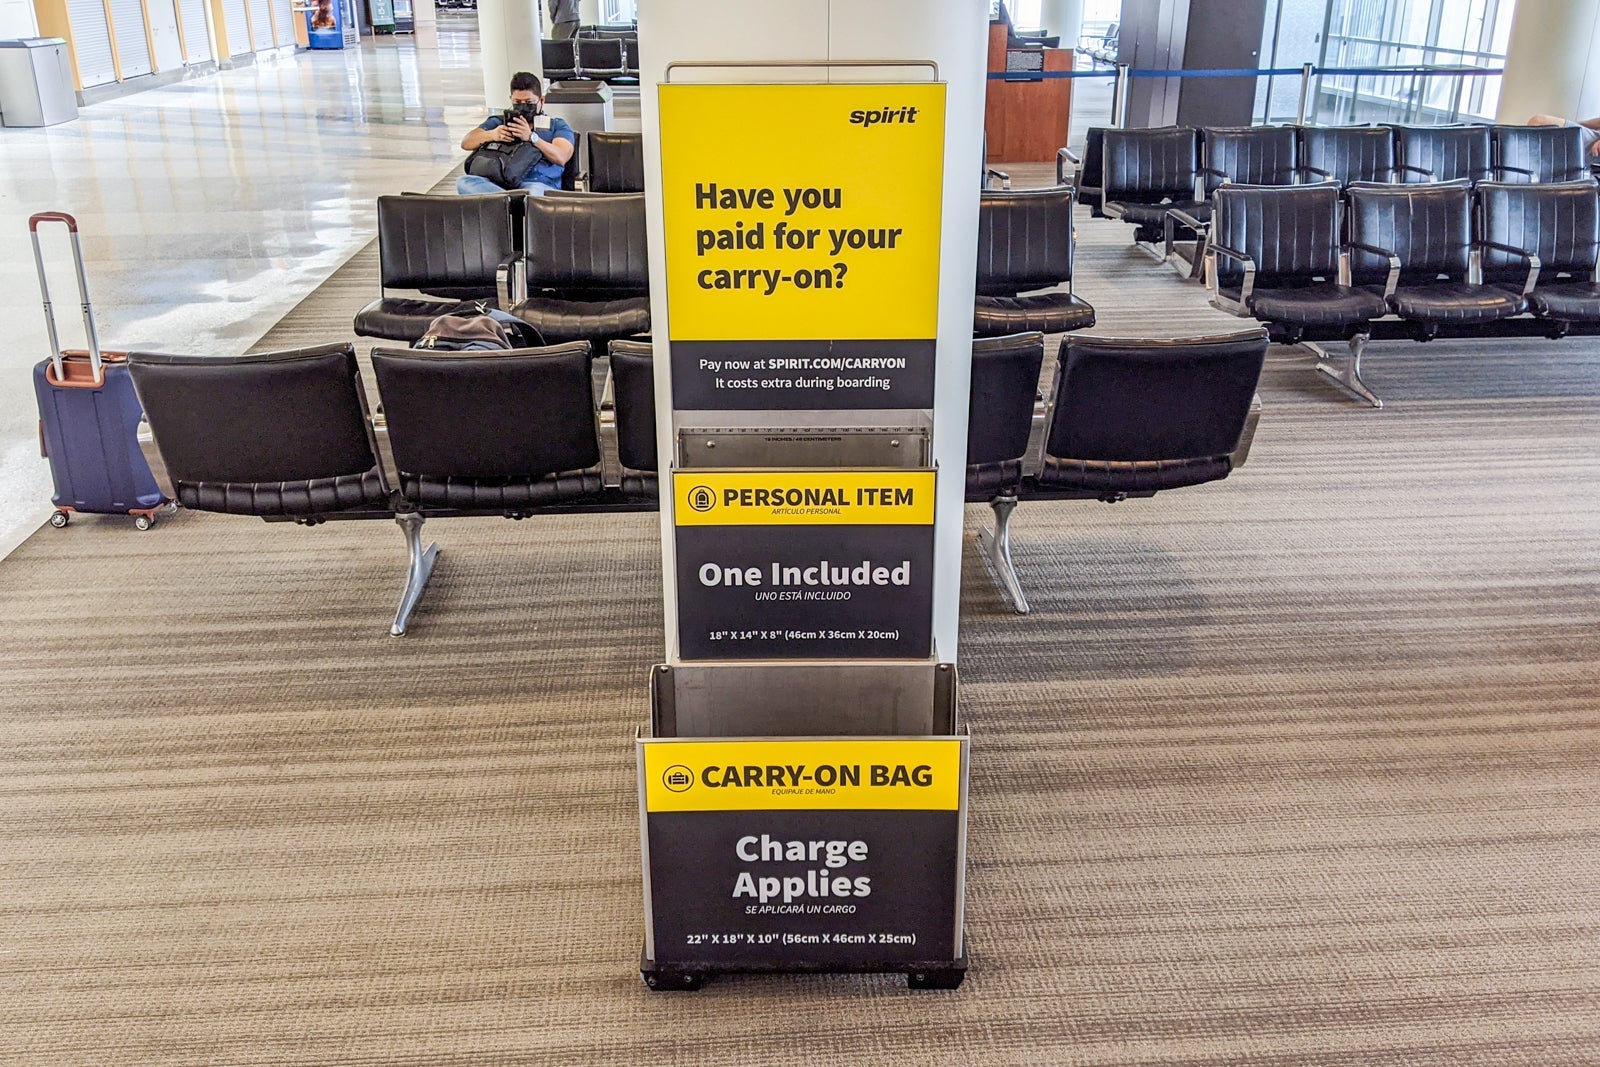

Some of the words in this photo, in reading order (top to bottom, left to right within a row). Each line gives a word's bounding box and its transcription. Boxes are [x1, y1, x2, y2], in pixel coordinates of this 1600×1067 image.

[849, 106, 919, 127] spirit
[695, 183, 774, 209] Have
[783, 188, 842, 216] you
[696, 221, 765, 256] paid
[773, 222, 821, 250] for
[828, 227, 903, 256] your
[697, 262, 849, 296] carry-on?
[699, 359, 722, 372] Pay
[724, 360, 750, 370] now
[753, 359, 765, 370] at
[769, 358, 906, 370] SPIRIT.COM/CARRYON
[715, 378, 724, 388] It
[727, 378, 758, 388] costs
[761, 378, 792, 388] extra
[795, 377, 834, 391] during
[837, 376, 890, 391] boarding
[723, 488, 850, 506] PERSONAL
[857, 488, 913, 506] ITEM
[771, 507, 805, 515] ARTÍCULO
[699, 562, 762, 586] One
[771, 560, 911, 586] Included
[755, 591, 778, 601] UNO
[778, 589, 804, 601] ESTÁ
[804, 591, 851, 601] INCLUIDO
[709, 631, 728, 640] 18"
[730, 631, 738, 640] X
[740, 631, 758, 640] 14"
[761, 631, 768, 640] X
[770, 630, 782, 640] 8"
[785, 630, 817, 641] (46cm
[819, 630, 826, 639] X
[827, 630, 858, 640] 36cm
[858, 630, 866, 639] X
[867, 630, 899, 641] 20cm)
[701, 764, 861, 788] CARRY-ON
[870, 765, 933, 787] BAG
[735, 834, 868, 868] Charge
[732, 870, 871, 903] Applies
[745, 905, 757, 914] SE
[758, 903, 805, 915] APLICARÁ
[806, 905, 821, 914] UN
[823, 905, 856, 914] CARGO
[686, 934, 709, 944] 22"
[711, 934, 720, 944] X
[722, 934, 743, 944] 18"
[746, 934, 755, 944] X
[758, 934, 779, 944] 10"
[782, 933, 820, 946] (56cm
[822, 934, 830, 944] X
[832, 934, 866, 944] 46cm
[868, 934, 877, 944] X
[879, 933, 917, 946] 25cm)
